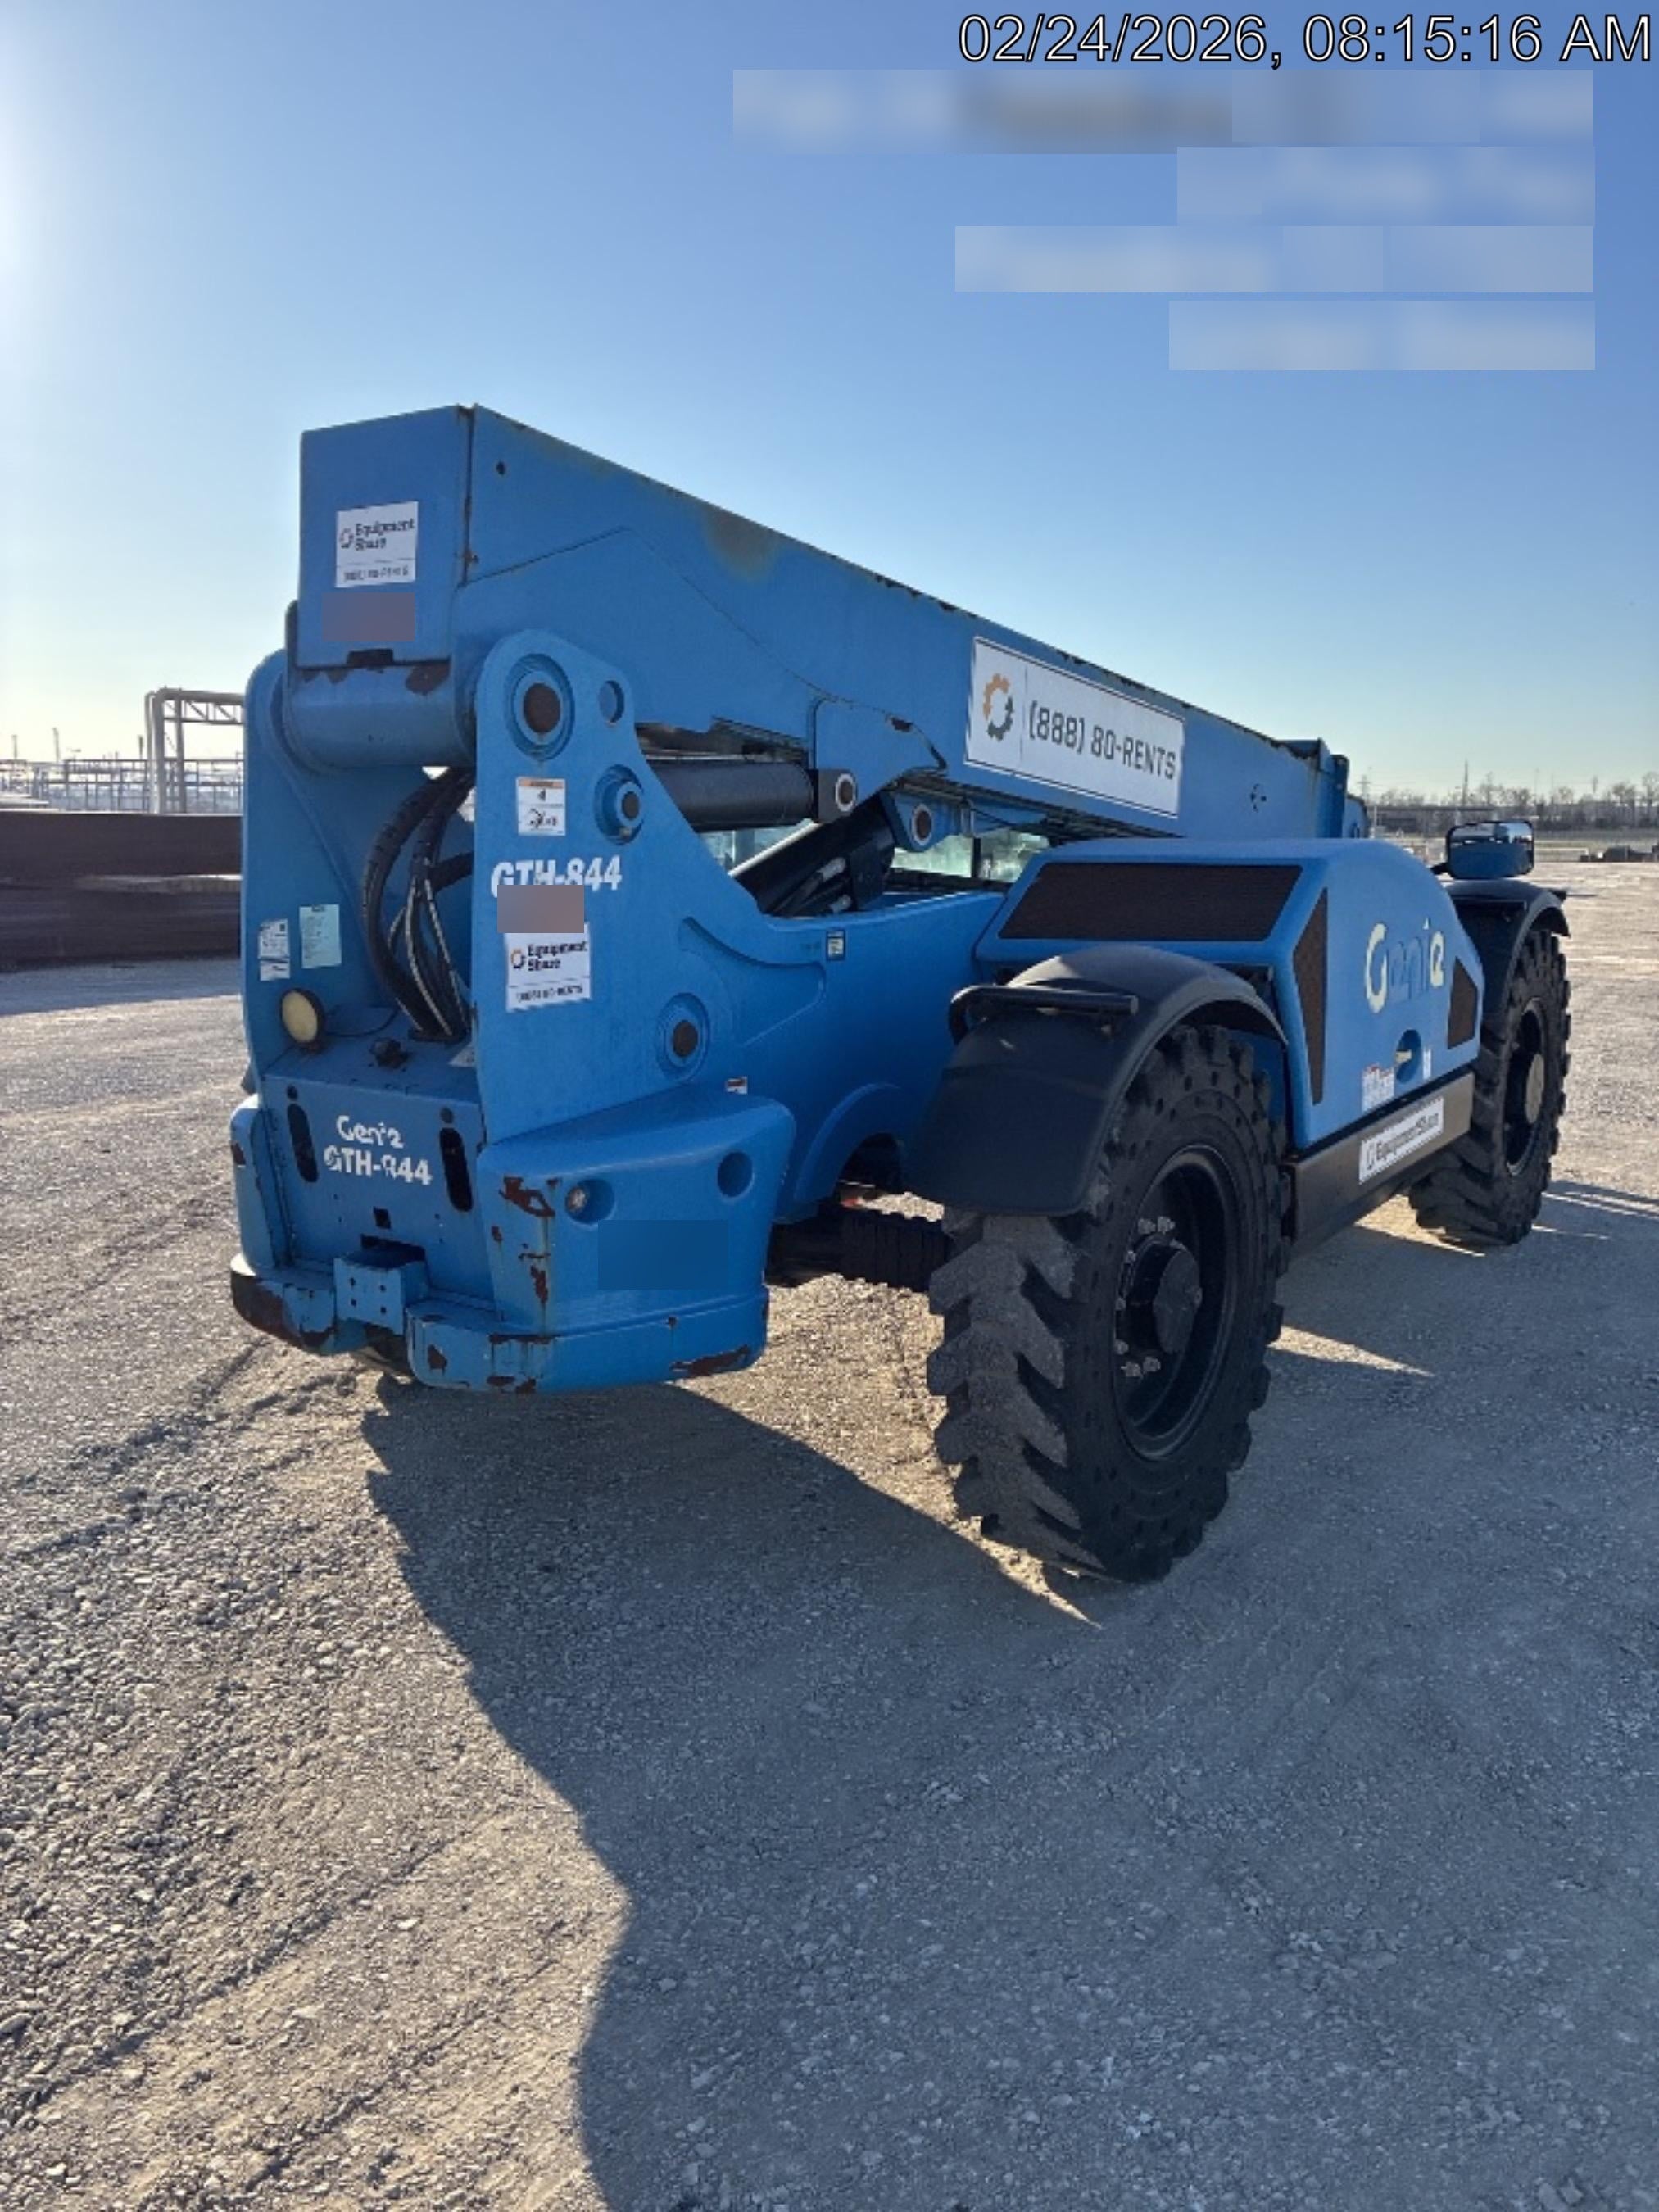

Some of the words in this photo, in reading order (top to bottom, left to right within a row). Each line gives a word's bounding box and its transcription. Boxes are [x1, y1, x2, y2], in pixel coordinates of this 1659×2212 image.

[1029, 700, 1086, 755] (888)
[1090, 724, 1176, 780] 80-RENTS
[491, 855, 623, 899] GTH-844
[1364, 916, 1444, 1014] Gie
